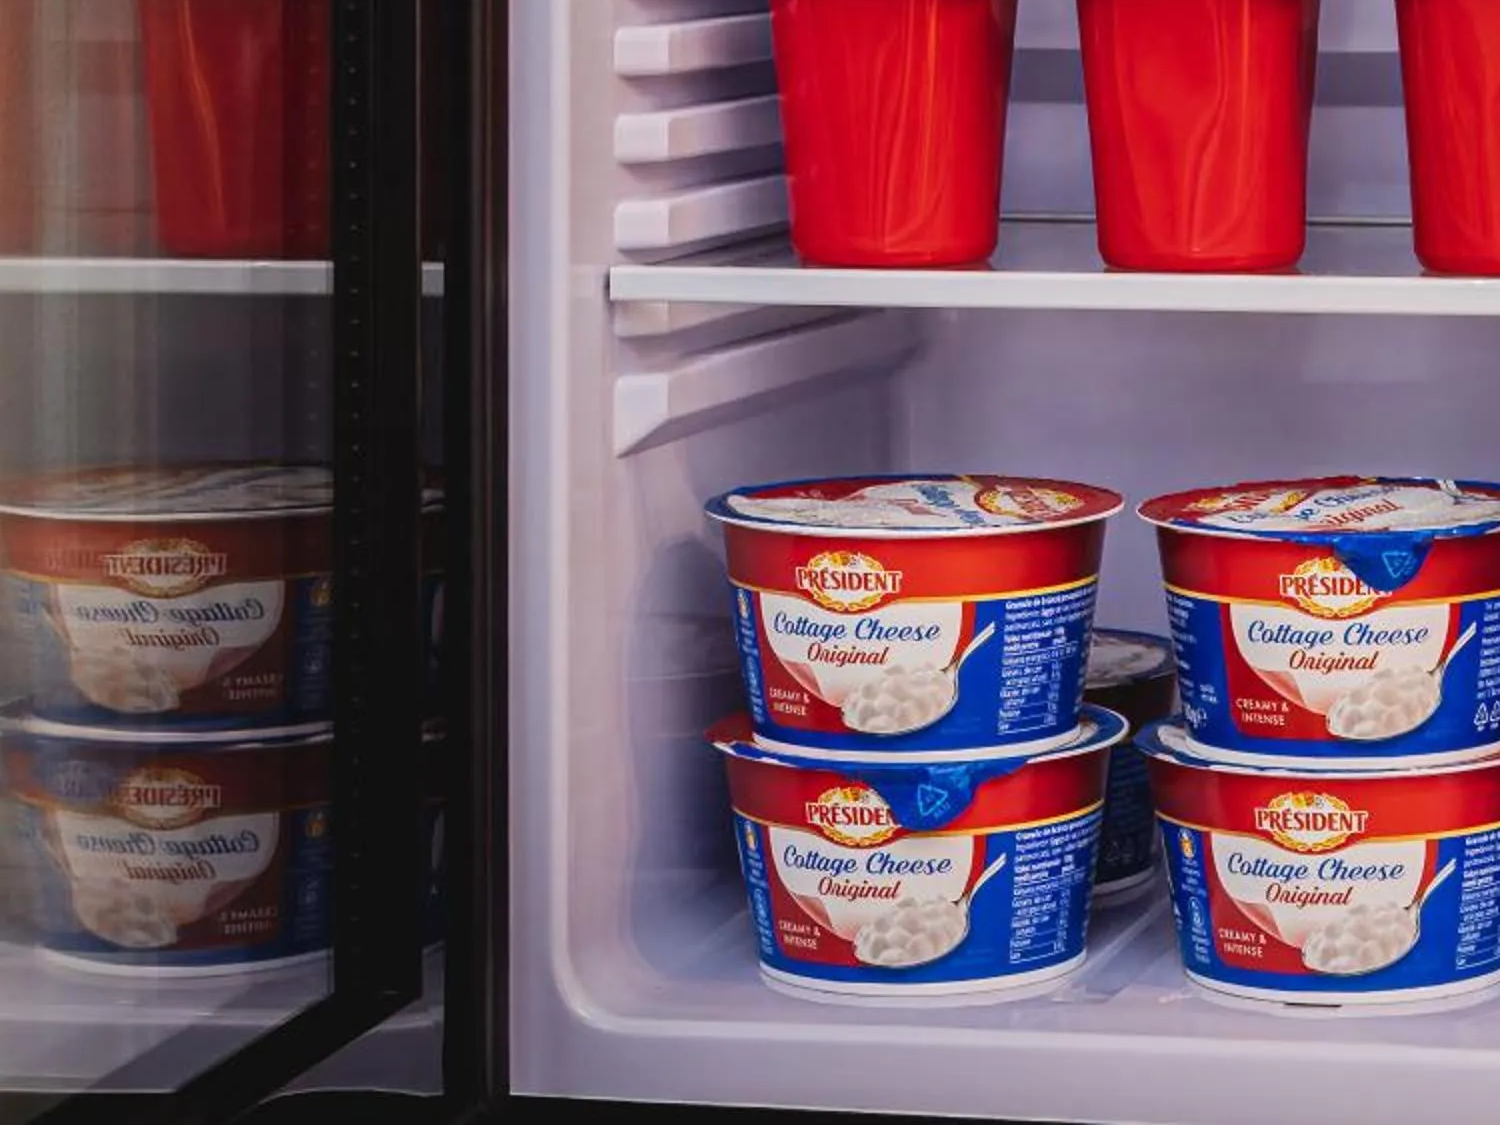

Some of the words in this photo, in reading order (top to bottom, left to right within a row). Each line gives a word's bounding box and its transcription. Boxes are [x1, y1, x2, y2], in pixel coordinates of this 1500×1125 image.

[798, 565, 901, 593] PRÉSIDENT
[1281, 573, 1381, 597] PRÉSIDE
[772, 613, 847, 644] Cottage
[854, 617, 942, 642] Cheese
[1247, 619, 1335, 652] Cottage
[1342, 622, 1430, 646] Cheese
[806, 641, 889, 669] Original
[1288, 648, 1380, 675] Original
[1235, 697, 1279, 713] CREAMY
[1280, 701, 1290, 713] &
[1241, 711, 1285, 727] INTENSE
[808, 803, 895, 827] PRÉSIDE
[1256, 806, 1368, 833] PRÉSIDENT
[783, 844, 859, 876] Cottage
[865, 851, 952, 876] Cheese
[1226, 851, 1308, 883] Cottage
[1316, 857, 1406, 883] Cheese
[818, 875, 901, 902] Original
[1265, 883, 1353, 911] Original
[1217, 927, 1257, 944] CREAMY
